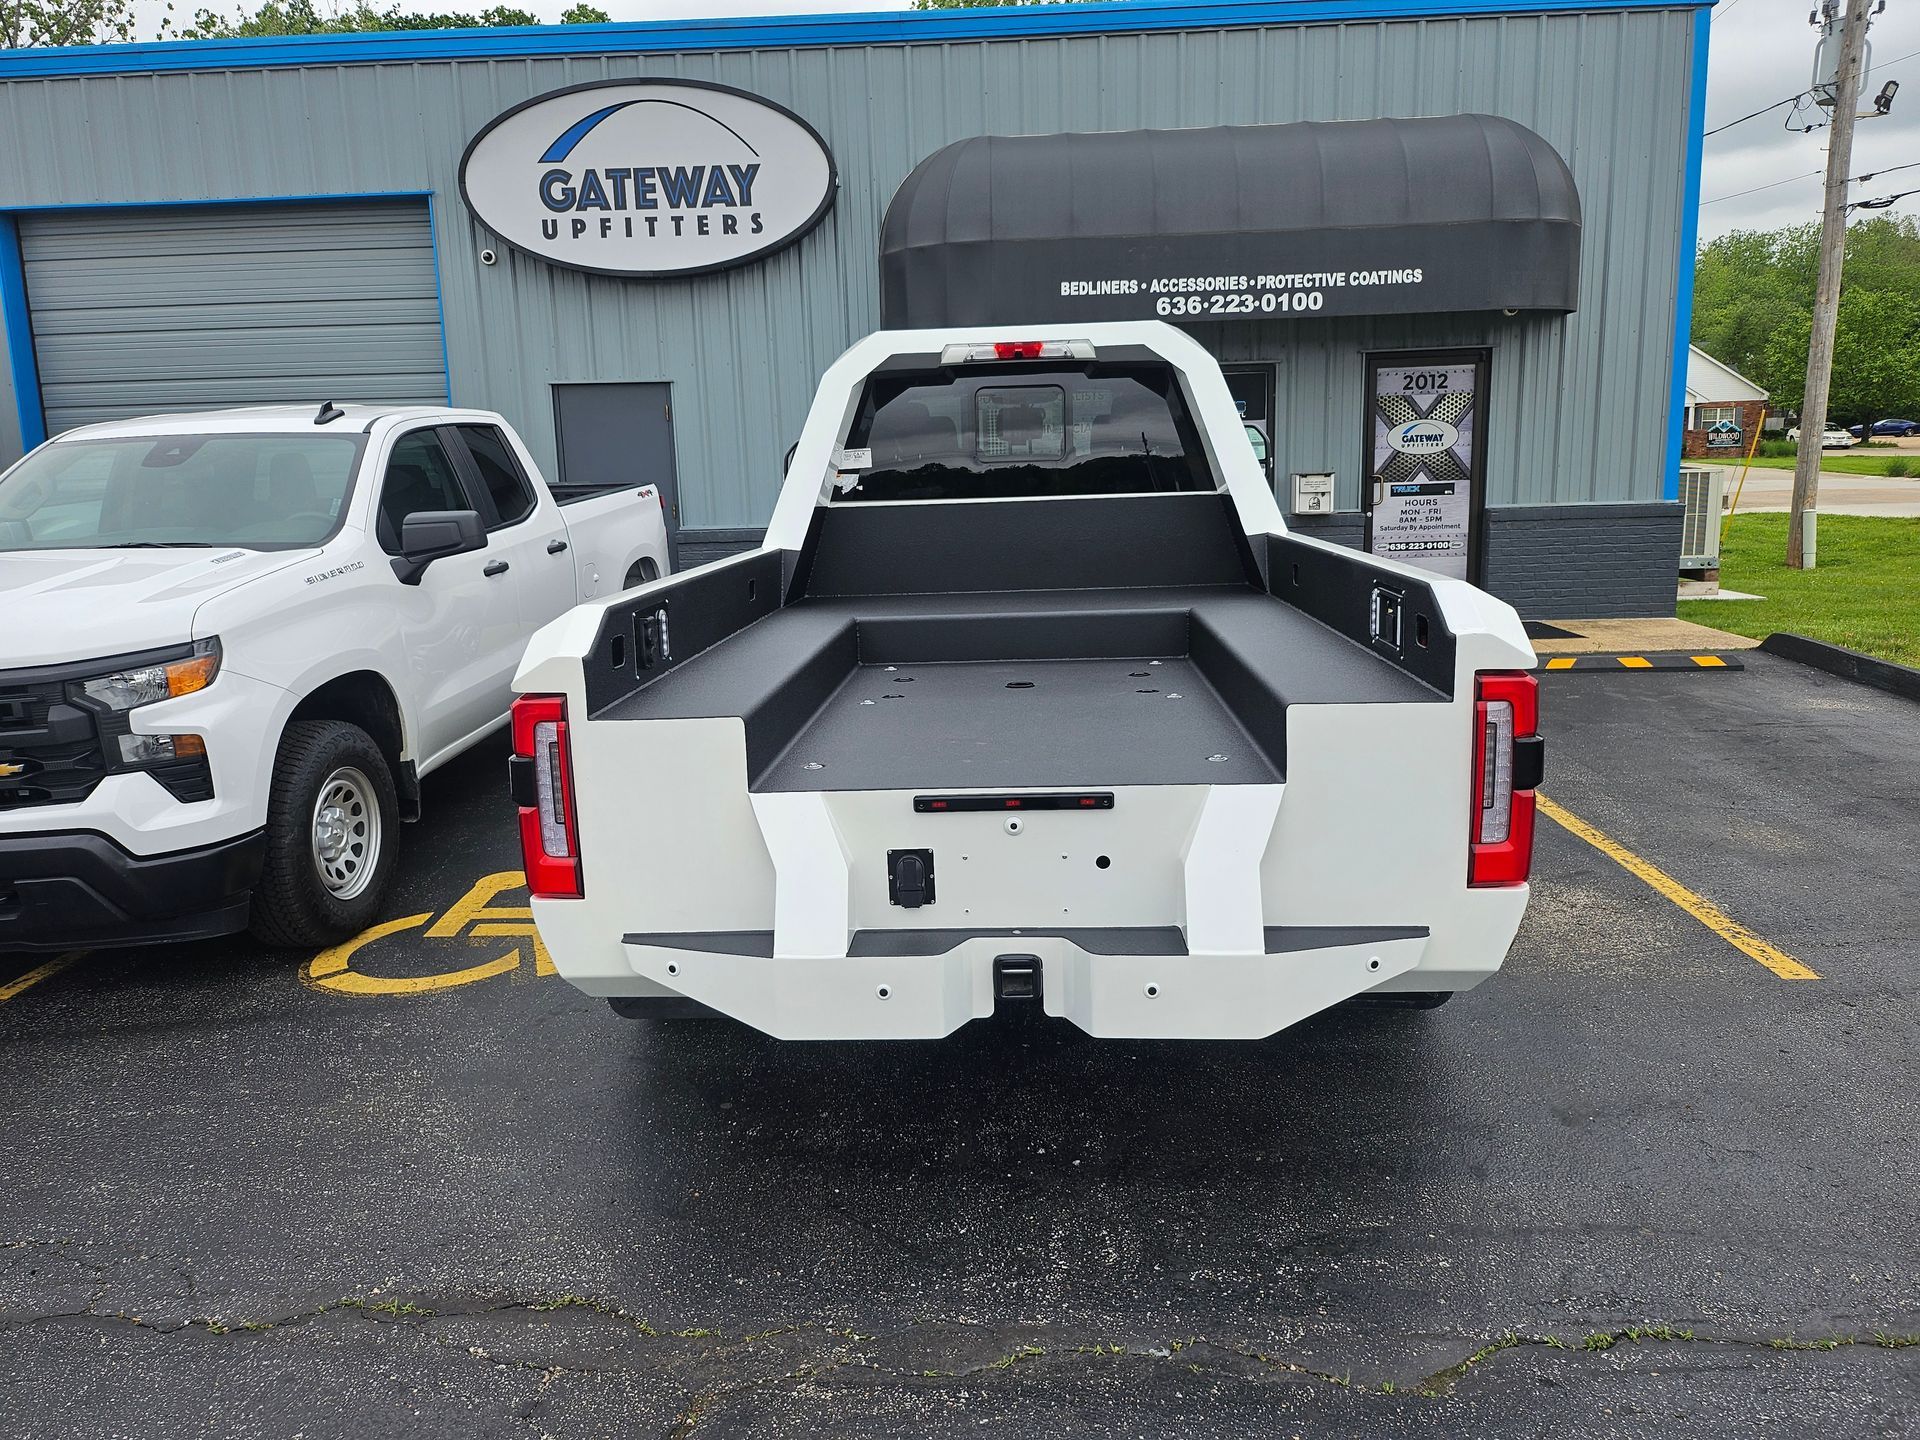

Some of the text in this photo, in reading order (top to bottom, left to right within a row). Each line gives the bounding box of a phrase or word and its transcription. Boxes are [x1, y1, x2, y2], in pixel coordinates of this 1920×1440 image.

[538, 163, 760, 213] GATEWAY
[541, 213, 764, 240] UPFITTERS
[1060, 269, 1423, 296] BEDLINERS ACCESSORIES PROTECTIVE COATINGS
[1402, 373, 1448, 391] 2012
[1401, 433, 1444, 443] GATEWAY
[1404, 498, 1438, 507] HOURS
[1418, 523, 1461, 531] Appointment
